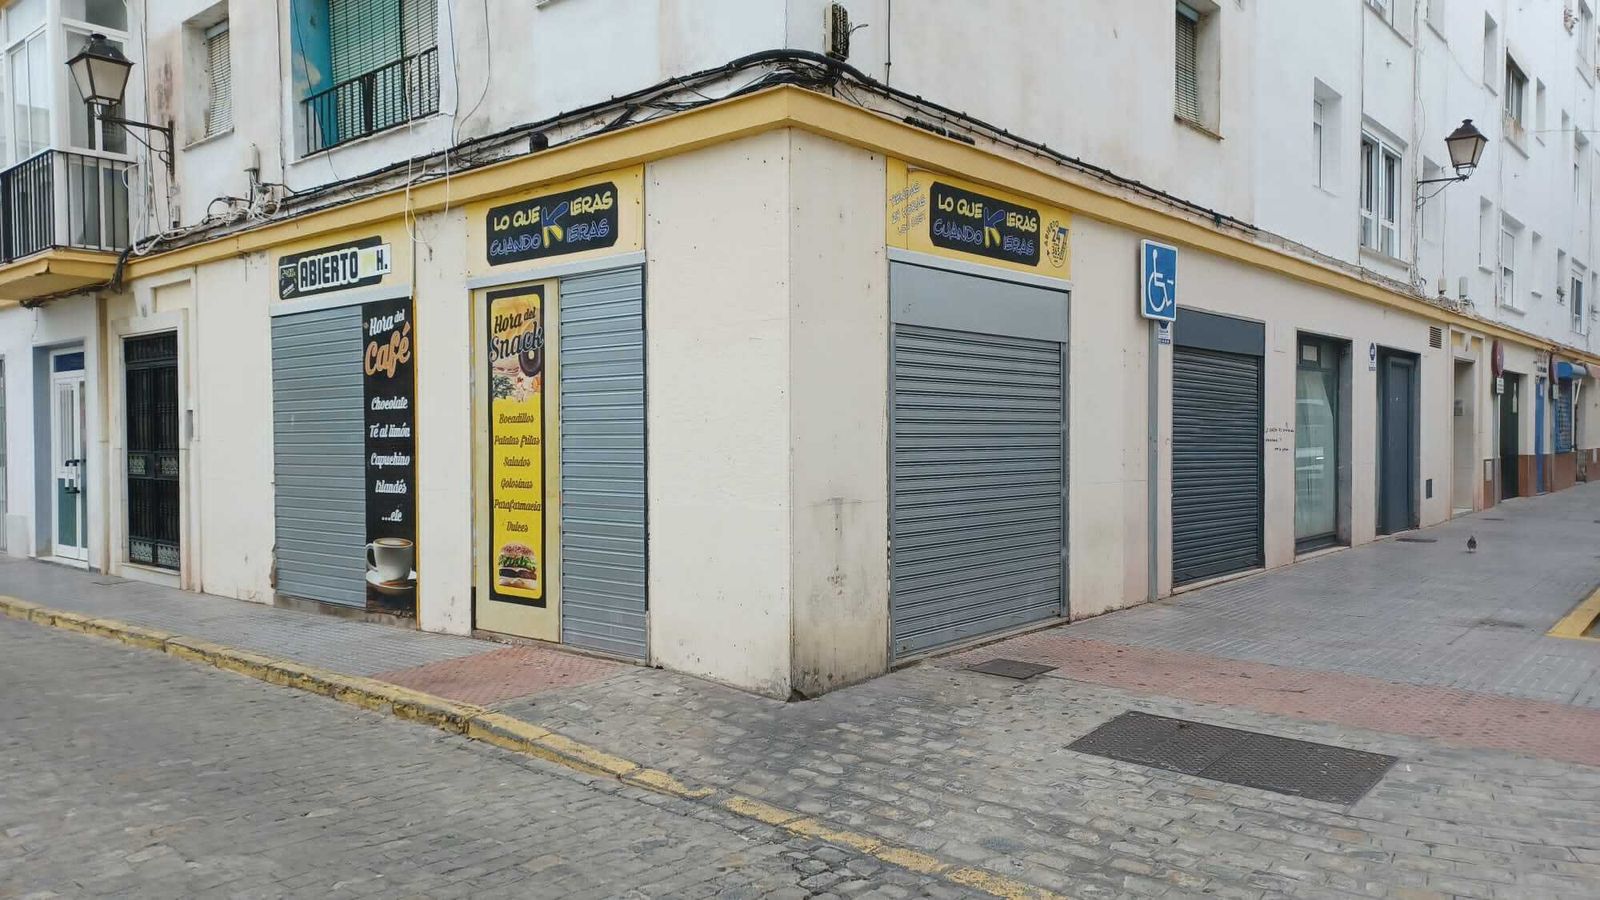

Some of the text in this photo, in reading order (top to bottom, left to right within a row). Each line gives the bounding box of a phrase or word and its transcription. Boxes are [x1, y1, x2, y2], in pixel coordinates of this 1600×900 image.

[938, 193, 954, 212] LO
[957, 198, 984, 220] QUE
[493, 215, 510, 231] LO
[512, 205, 541, 228] QUE
[933, 218, 984, 246] CUANDO
[490, 233, 542, 256] CUANDO
[299, 250, 359, 289] ABIERTO
[369, 309, 405, 337] Hora del
[494, 306, 537, 334] Hora del
[365, 321, 411, 379] Café
[489, 321, 545, 362] Snack
[371, 396, 408, 410] Chocolate
[499, 412, 534, 424] Bocadillos
[369, 422, 411, 438] Té al limón
[494, 435, 520, 446] Patatas
[370, 452, 411, 469] Capuchino
[503, 456, 531, 467] Salados
[375, 479, 407, 494] Irlandés
[501, 478, 533, 490] Golosinas
[494, 499, 541, 512] Parafarmacia
[506, 521, 529, 533] Dulces
